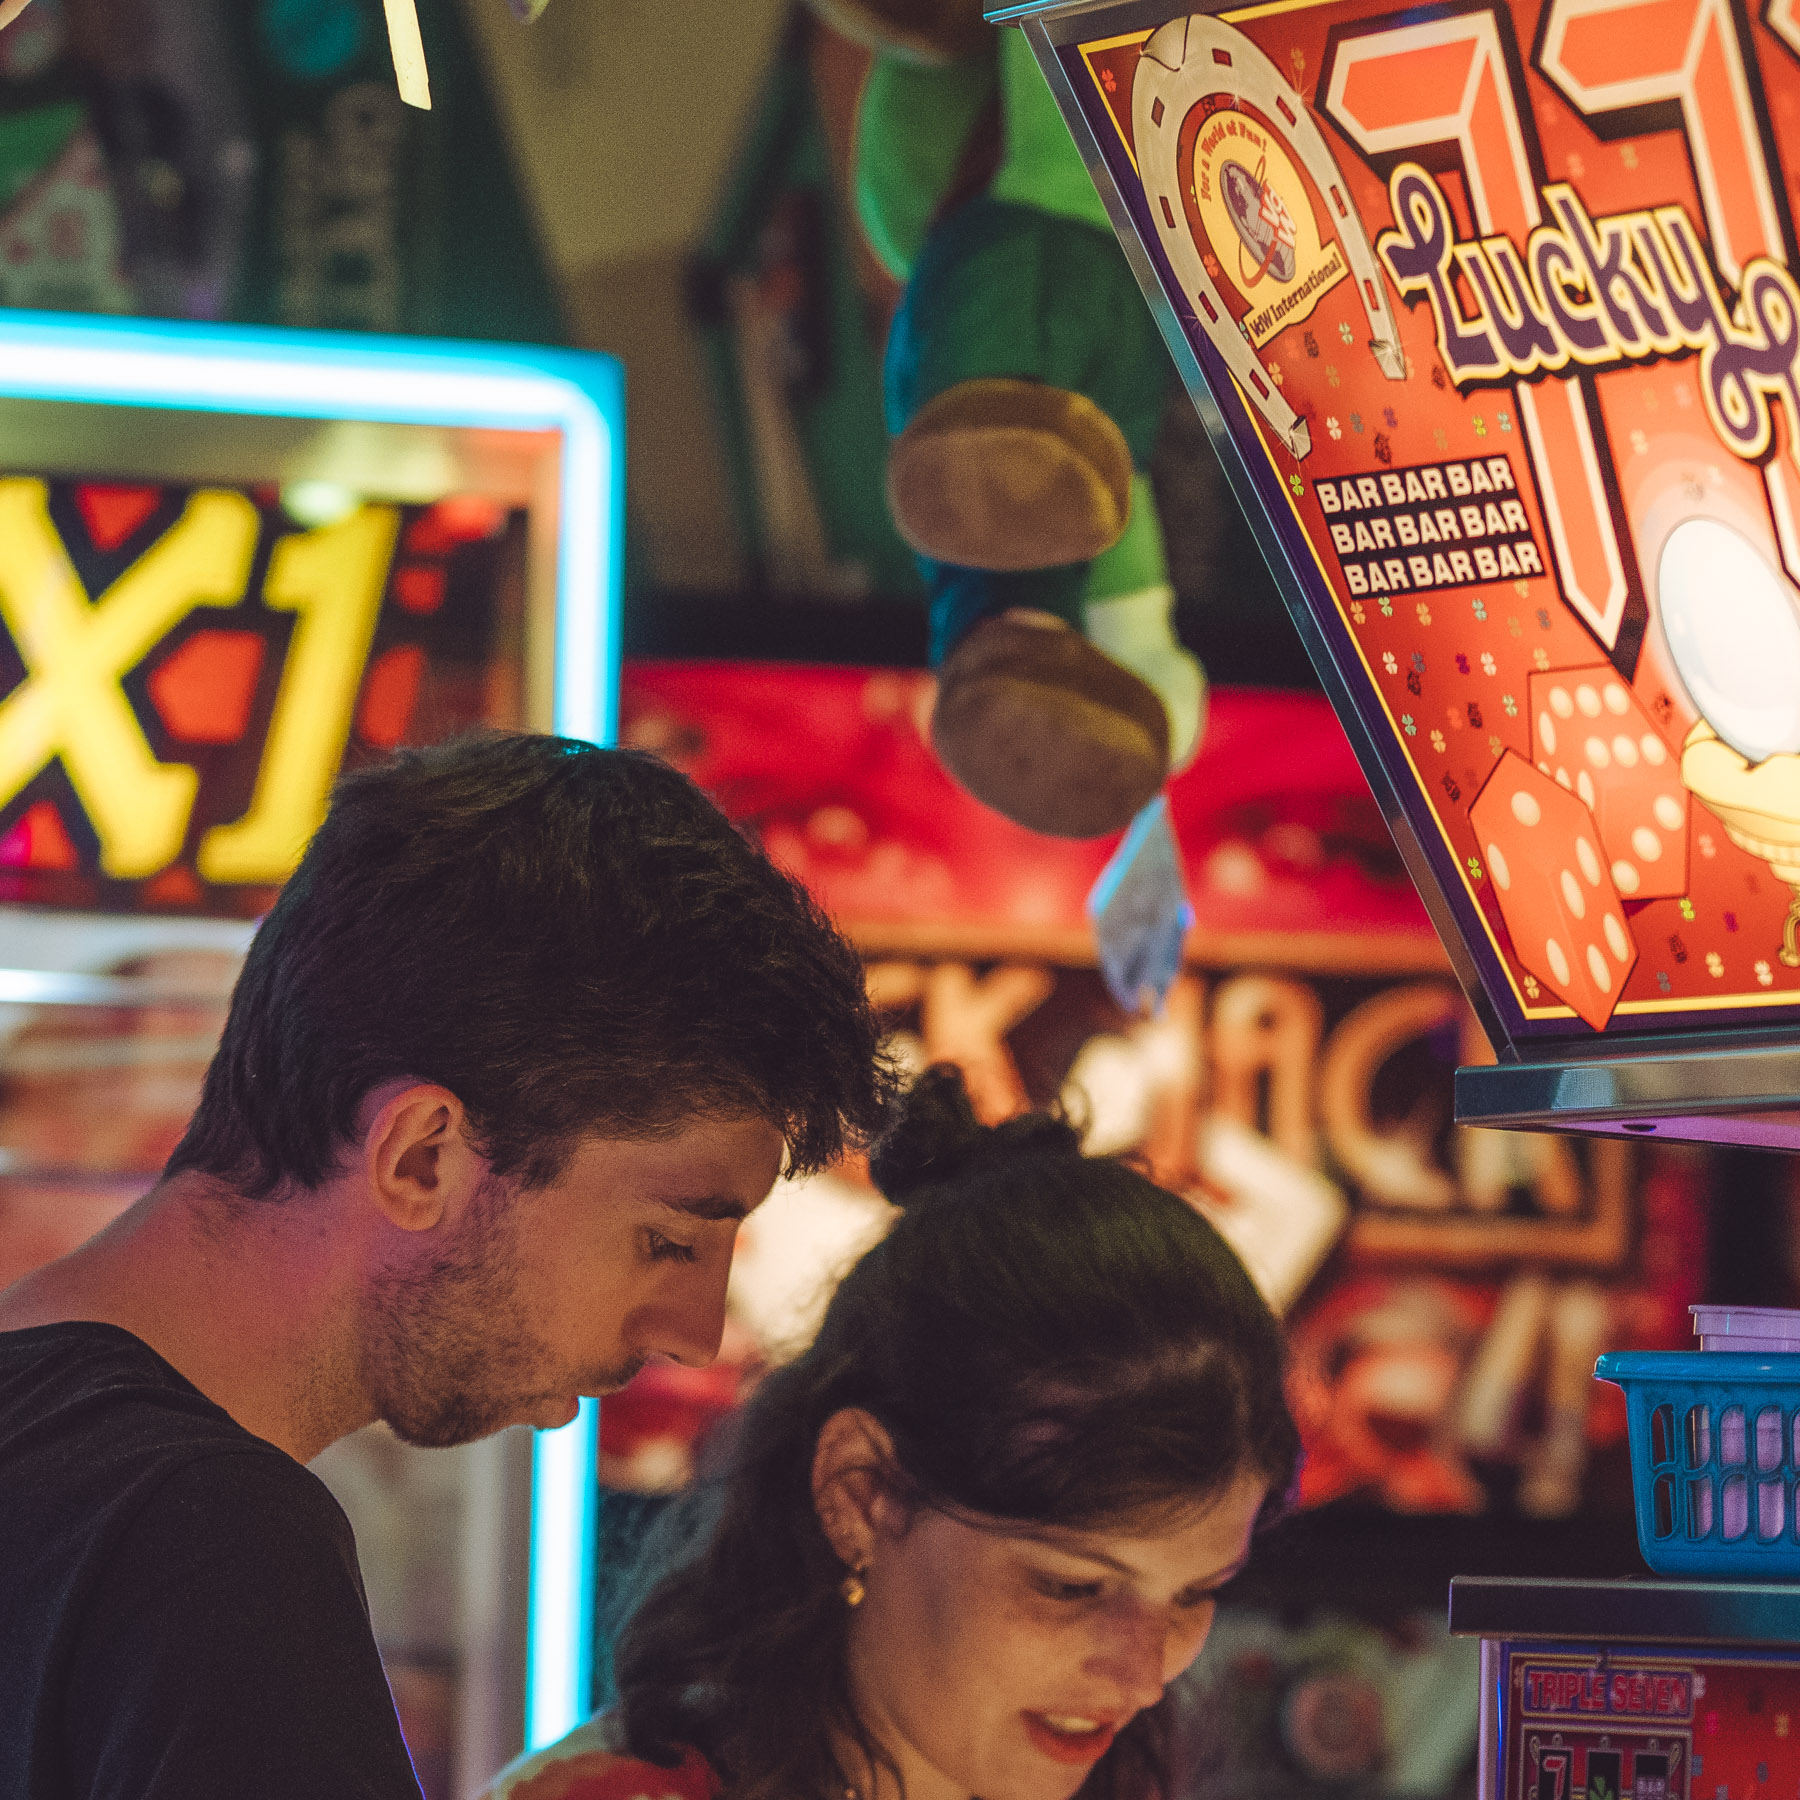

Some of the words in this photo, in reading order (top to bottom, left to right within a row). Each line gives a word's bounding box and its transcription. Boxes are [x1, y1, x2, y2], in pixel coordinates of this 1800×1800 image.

[1271, 252, 1343, 328] International
[1377, 160, 1775, 462] Lucky
[1317, 477, 1383, 514] BAR
[1380, 467, 1449, 505] BAR
[1445, 457, 1516, 497] BAR
[1330, 518, 1398, 555] BAR
[1393, 508, 1462, 547] BAR
[1459, 499, 1530, 539] BAR
[1343, 559, 1411, 595] BAR
[1407, 550, 1477, 588] BAR
[1473, 541, 1544, 580] BAR
[1528, 1670, 1604, 1711] TRIPLE
[1611, 1673, 1691, 1716] SEVEN
